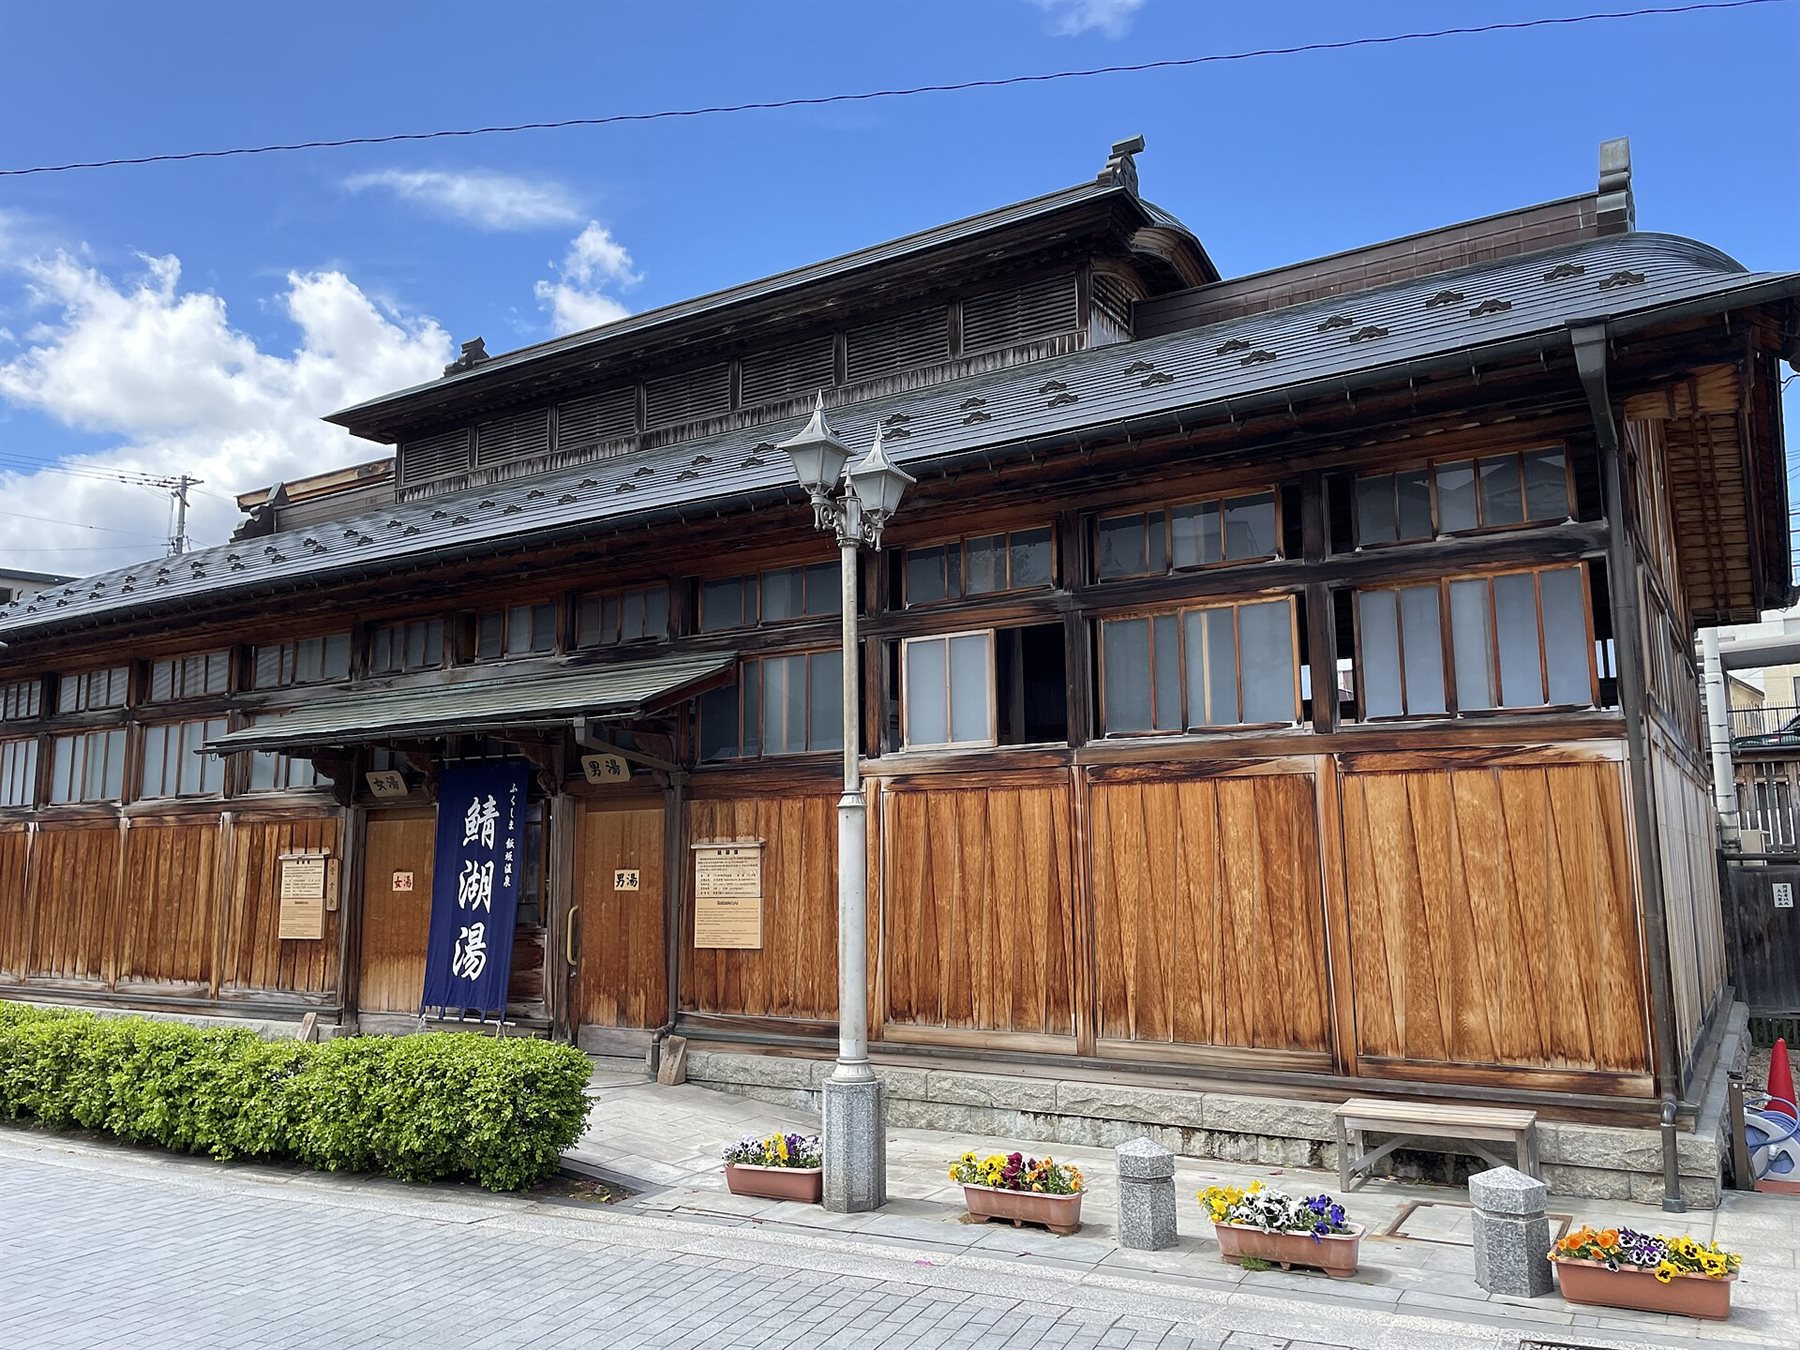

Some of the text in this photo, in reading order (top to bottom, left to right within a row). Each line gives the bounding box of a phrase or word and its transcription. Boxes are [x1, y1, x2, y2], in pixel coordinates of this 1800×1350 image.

[588, 758, 621, 777] 男湯
[373, 775, 400, 791] 女湯
[503, 783, 518, 888] ふくしま 飯坂温泉
[394, 875, 412, 889] 女湯
[452, 794, 500, 981] 鯖湖湯
[616, 872, 638, 888] 男湯
